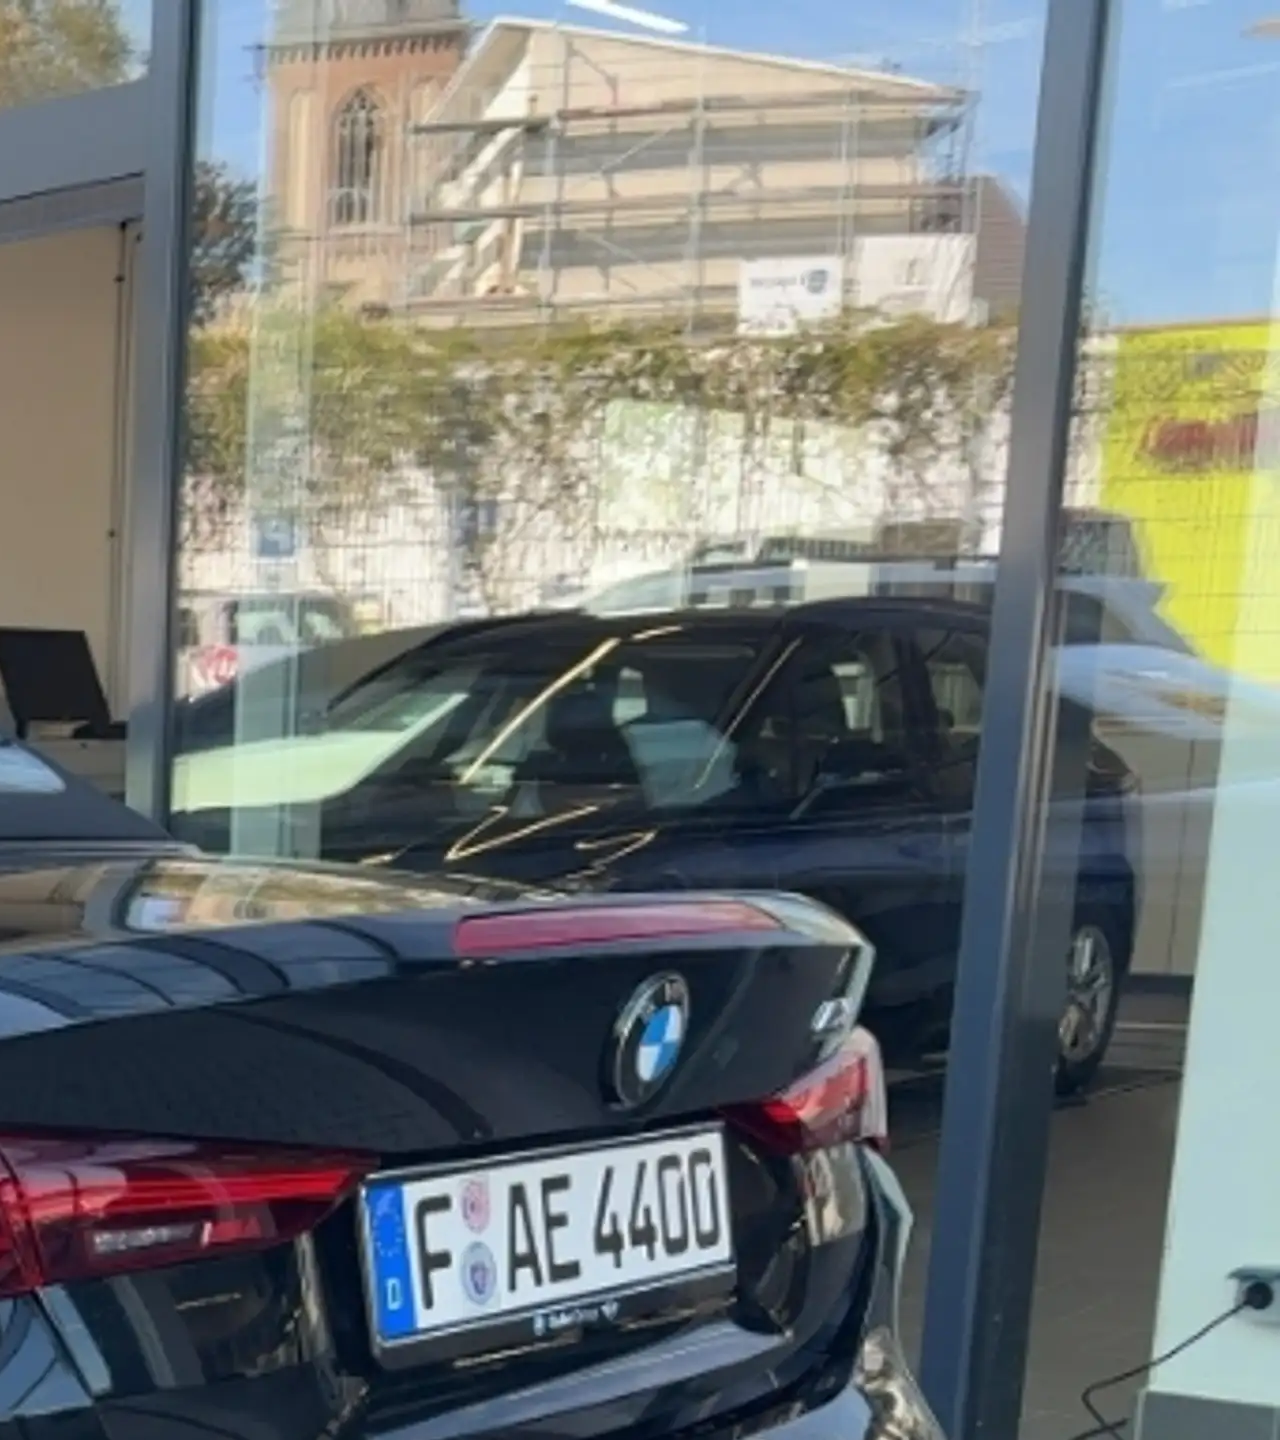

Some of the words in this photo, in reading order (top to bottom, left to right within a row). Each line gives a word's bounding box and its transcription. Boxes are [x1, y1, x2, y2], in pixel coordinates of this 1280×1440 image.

[415, 1193, 453, 1309] F
[508, 1174, 580, 1291] AE
[594, 1147, 721, 1269] 4400
[387, 1278, 402, 1310] D
